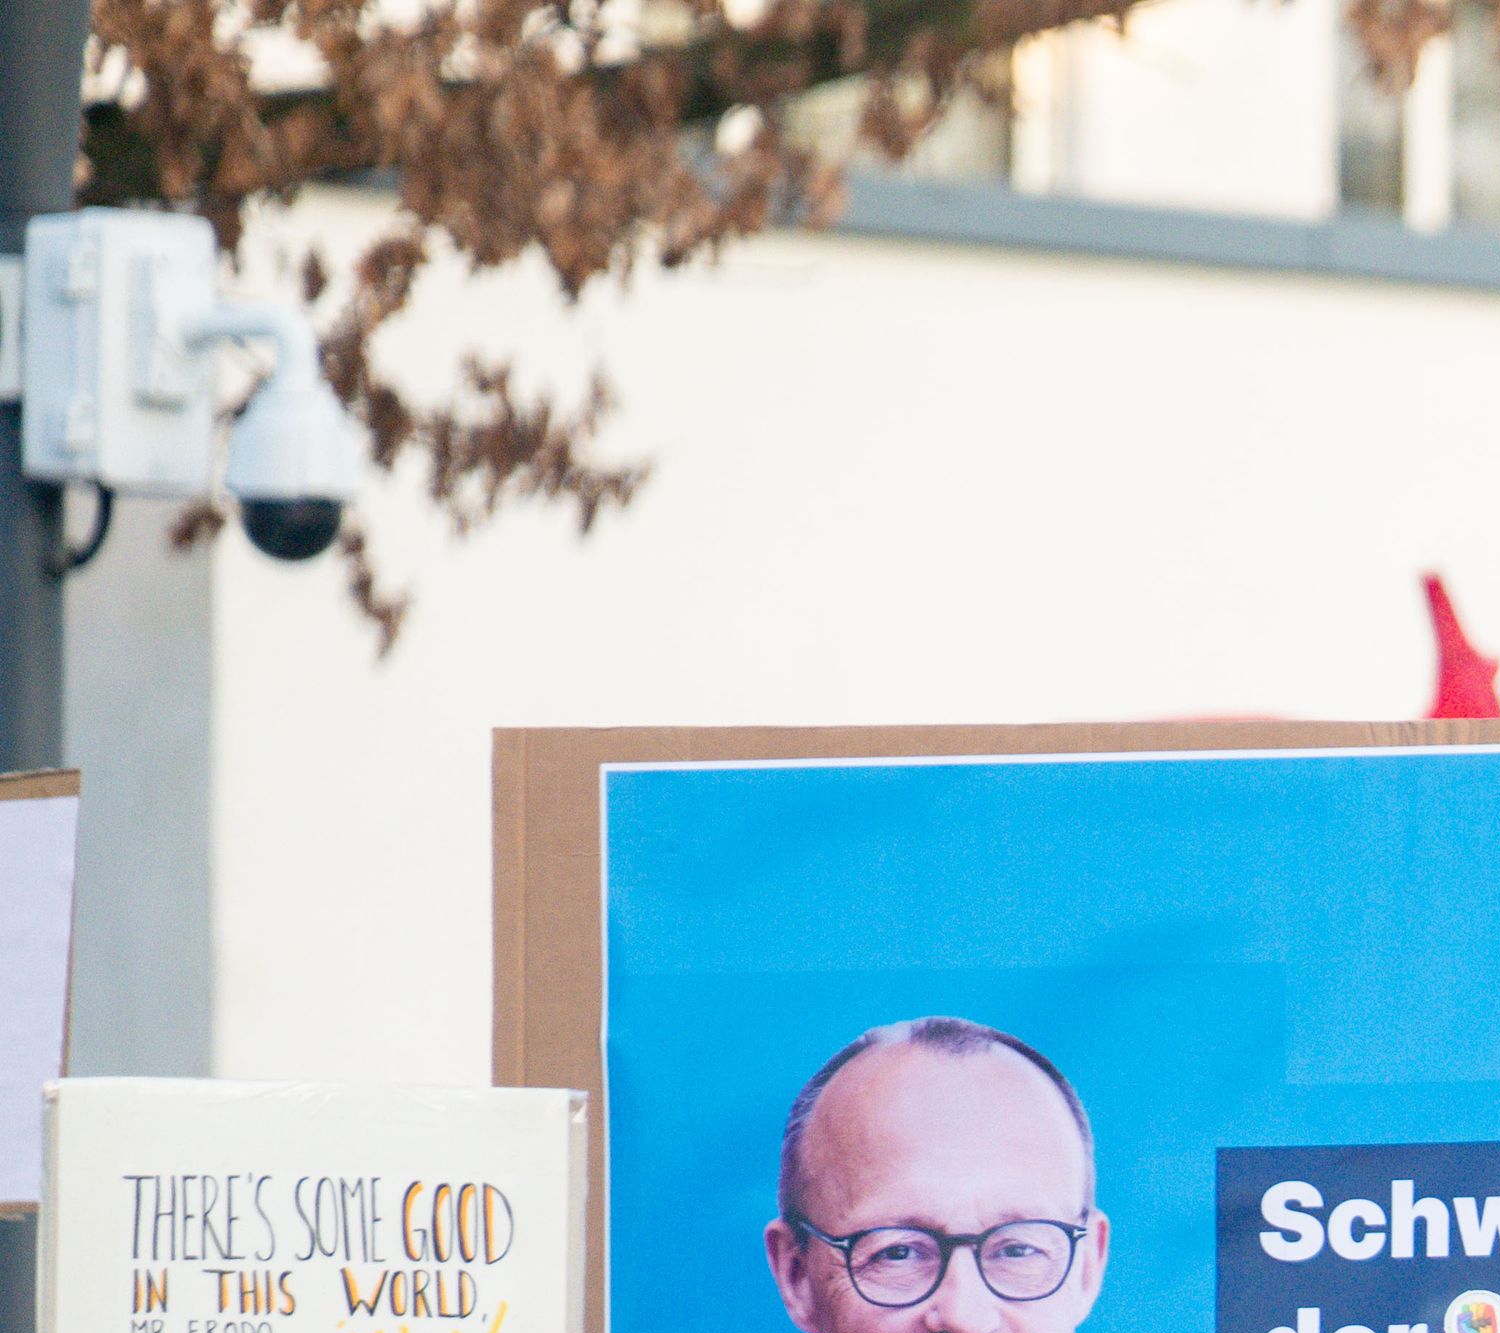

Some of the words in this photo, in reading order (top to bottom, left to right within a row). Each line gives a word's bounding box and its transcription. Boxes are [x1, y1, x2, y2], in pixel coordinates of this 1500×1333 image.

[123, 1173, 275, 1262] THERE'S
[294, 1176, 384, 1262] SOME
[402, 1180, 515, 1265] GOOD
[132, 1269, 169, 1315] IN
[212, 1268, 297, 1315] THIS
[340, 1268, 488, 1325] WORLD,
